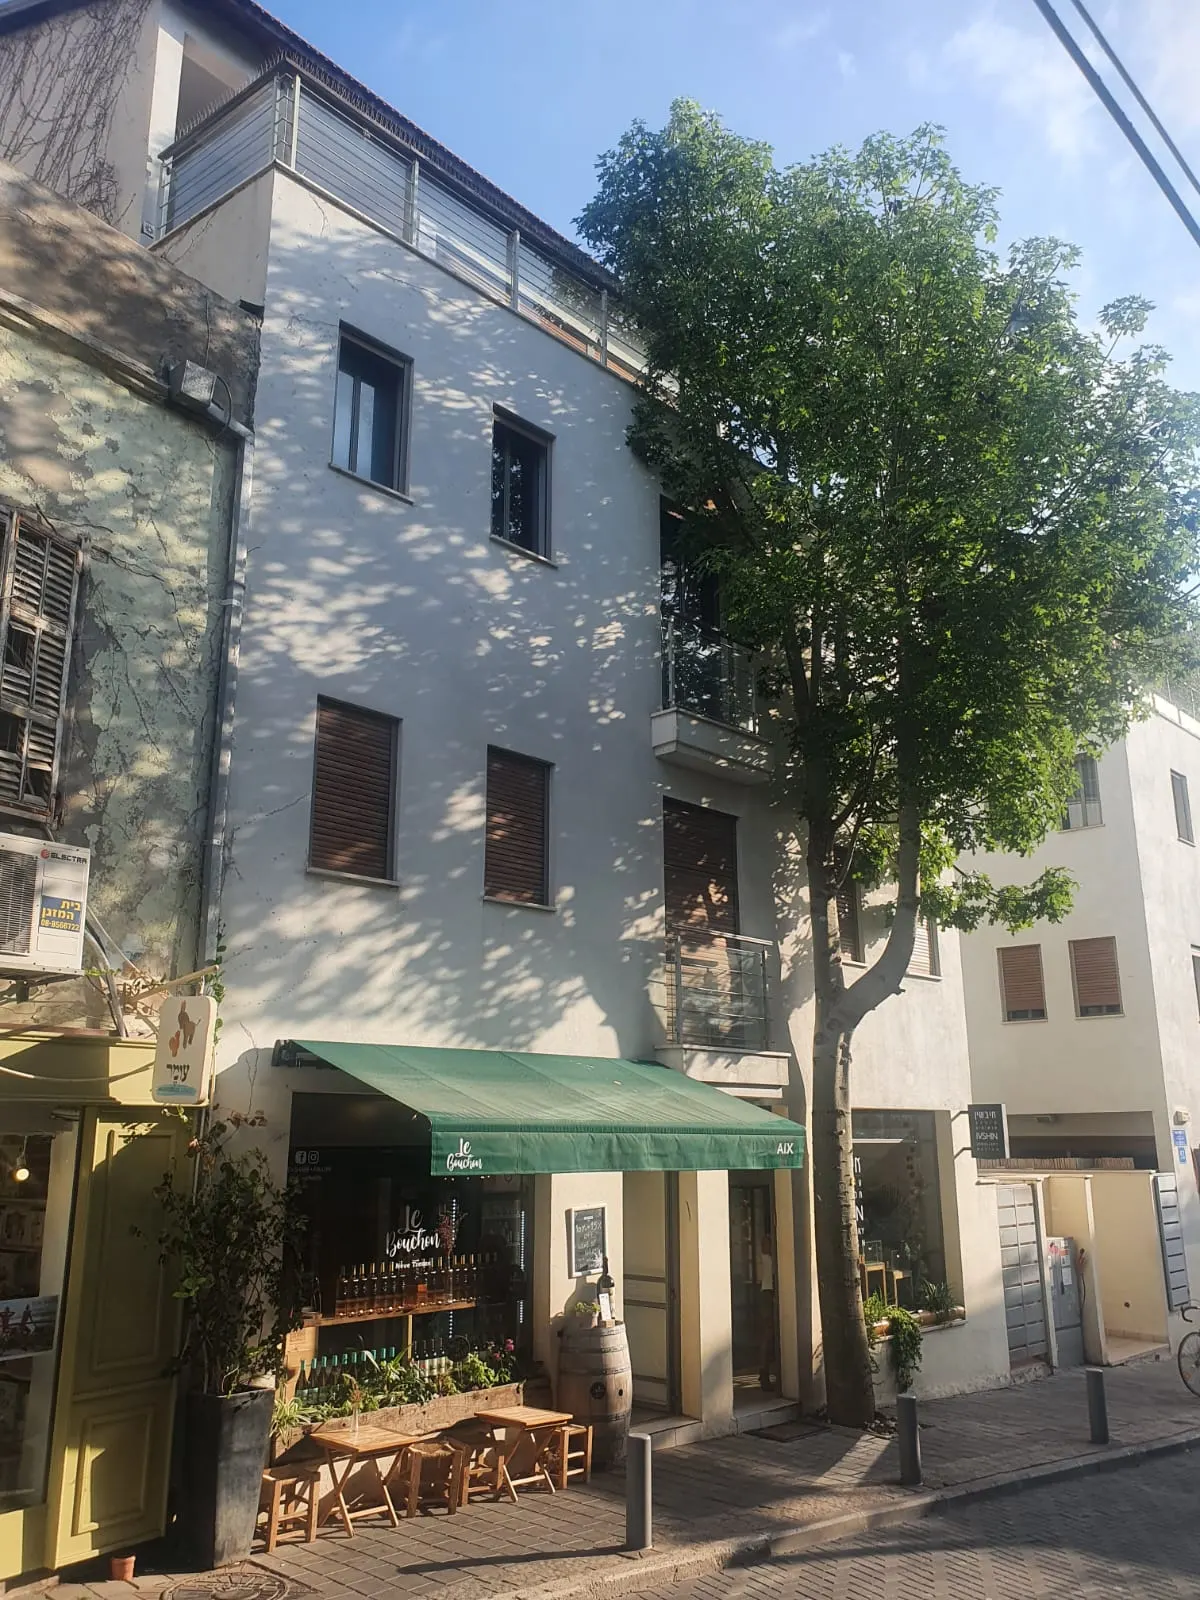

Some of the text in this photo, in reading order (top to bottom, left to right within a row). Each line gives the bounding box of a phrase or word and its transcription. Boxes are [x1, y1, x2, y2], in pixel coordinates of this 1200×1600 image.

[50, 852, 87, 864] ELECTRA
[61, 900, 81, 911] בית
[42, 907, 74, 920] המזגן
[455, 1138, 473, 1157] Le
[776, 1143, 794, 1154] AIX
[397, 1205, 425, 1234] Le
[385, 1228, 440, 1257] Bouchon
